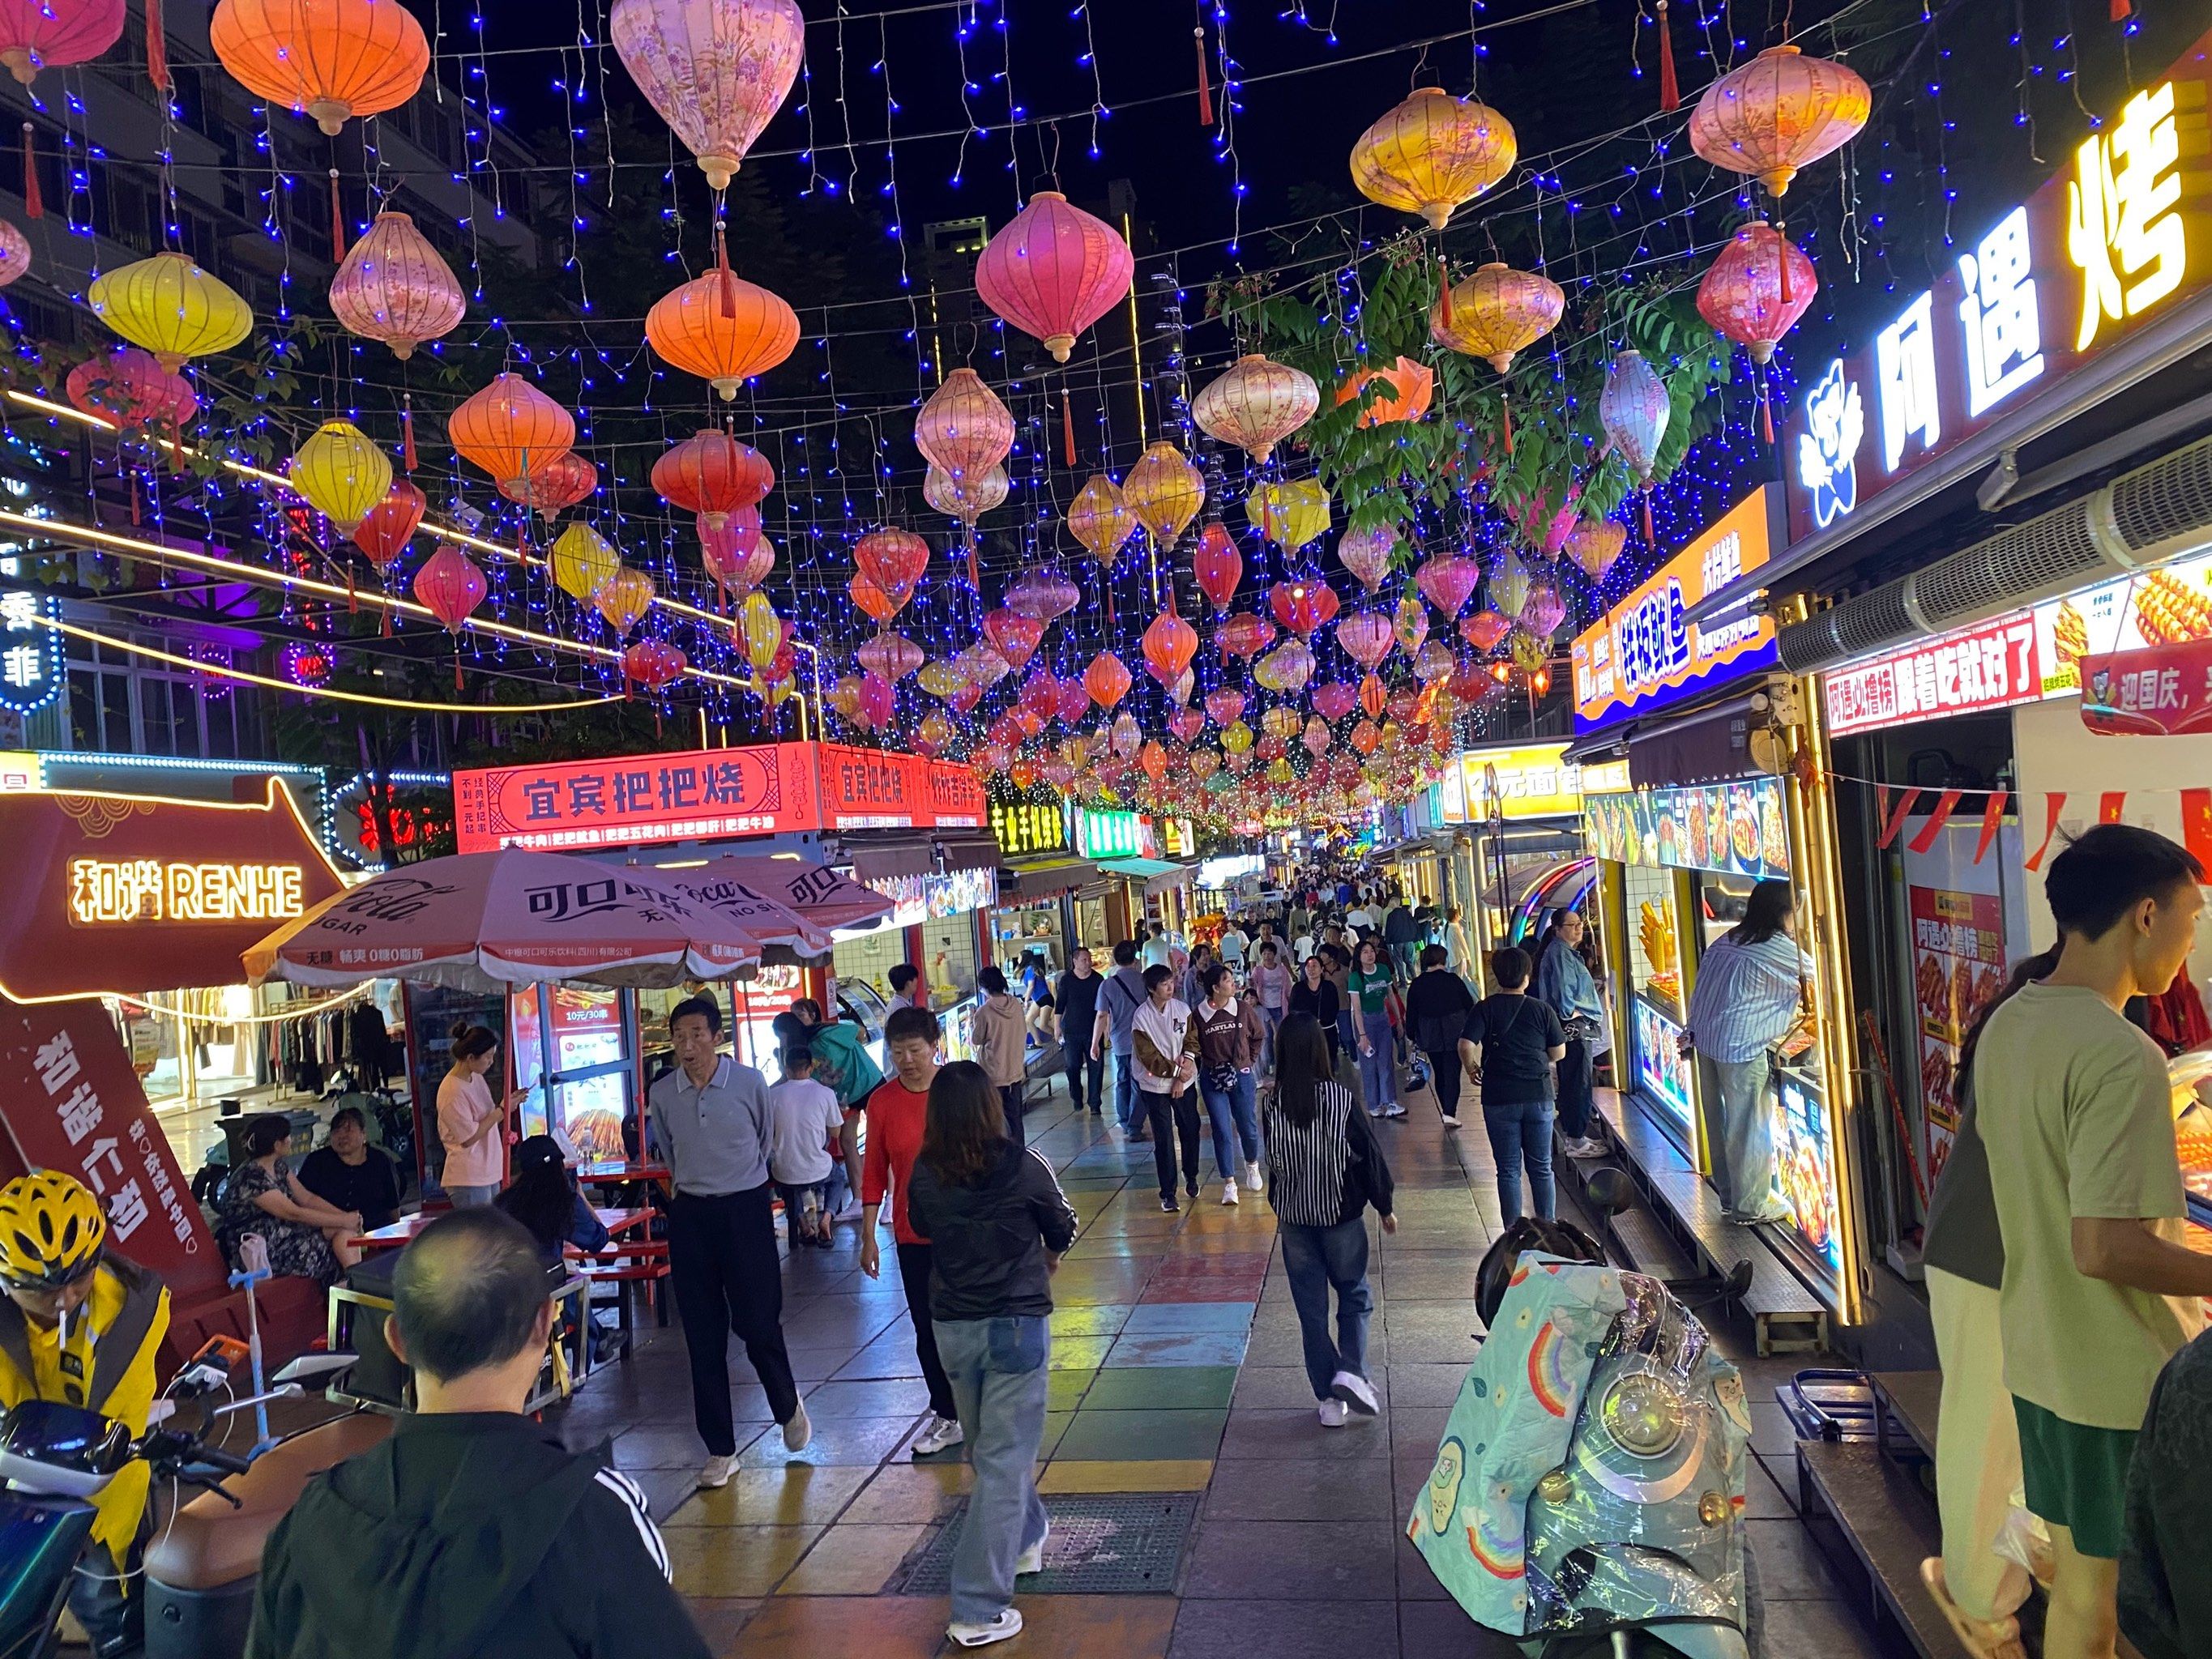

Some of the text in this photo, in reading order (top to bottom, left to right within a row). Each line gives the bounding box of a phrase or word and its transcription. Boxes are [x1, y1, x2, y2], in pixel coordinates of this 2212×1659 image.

[1877, 82, 2185, 471] 阿遇烤
[1894, 622, 2033, 714] 跟着吃就对了
[462, 778, 474, 834] 不到一元起
[523, 761, 745, 821] 宜宾把把烧
[841, 761, 903, 804] 宜宾把把烧
[168, 864, 303, 919] RENHE
[729, 907, 754, 918] NO
[339, 949, 366, 964] 畅爽
[566, 1009, 608, 1021] 10元/30串
[1205, 1022, 1243, 1035] MARYLAD
[33, 1030, 148, 1243] 和谐仁和
[143, 1152, 193, 1243] 依然是中国
